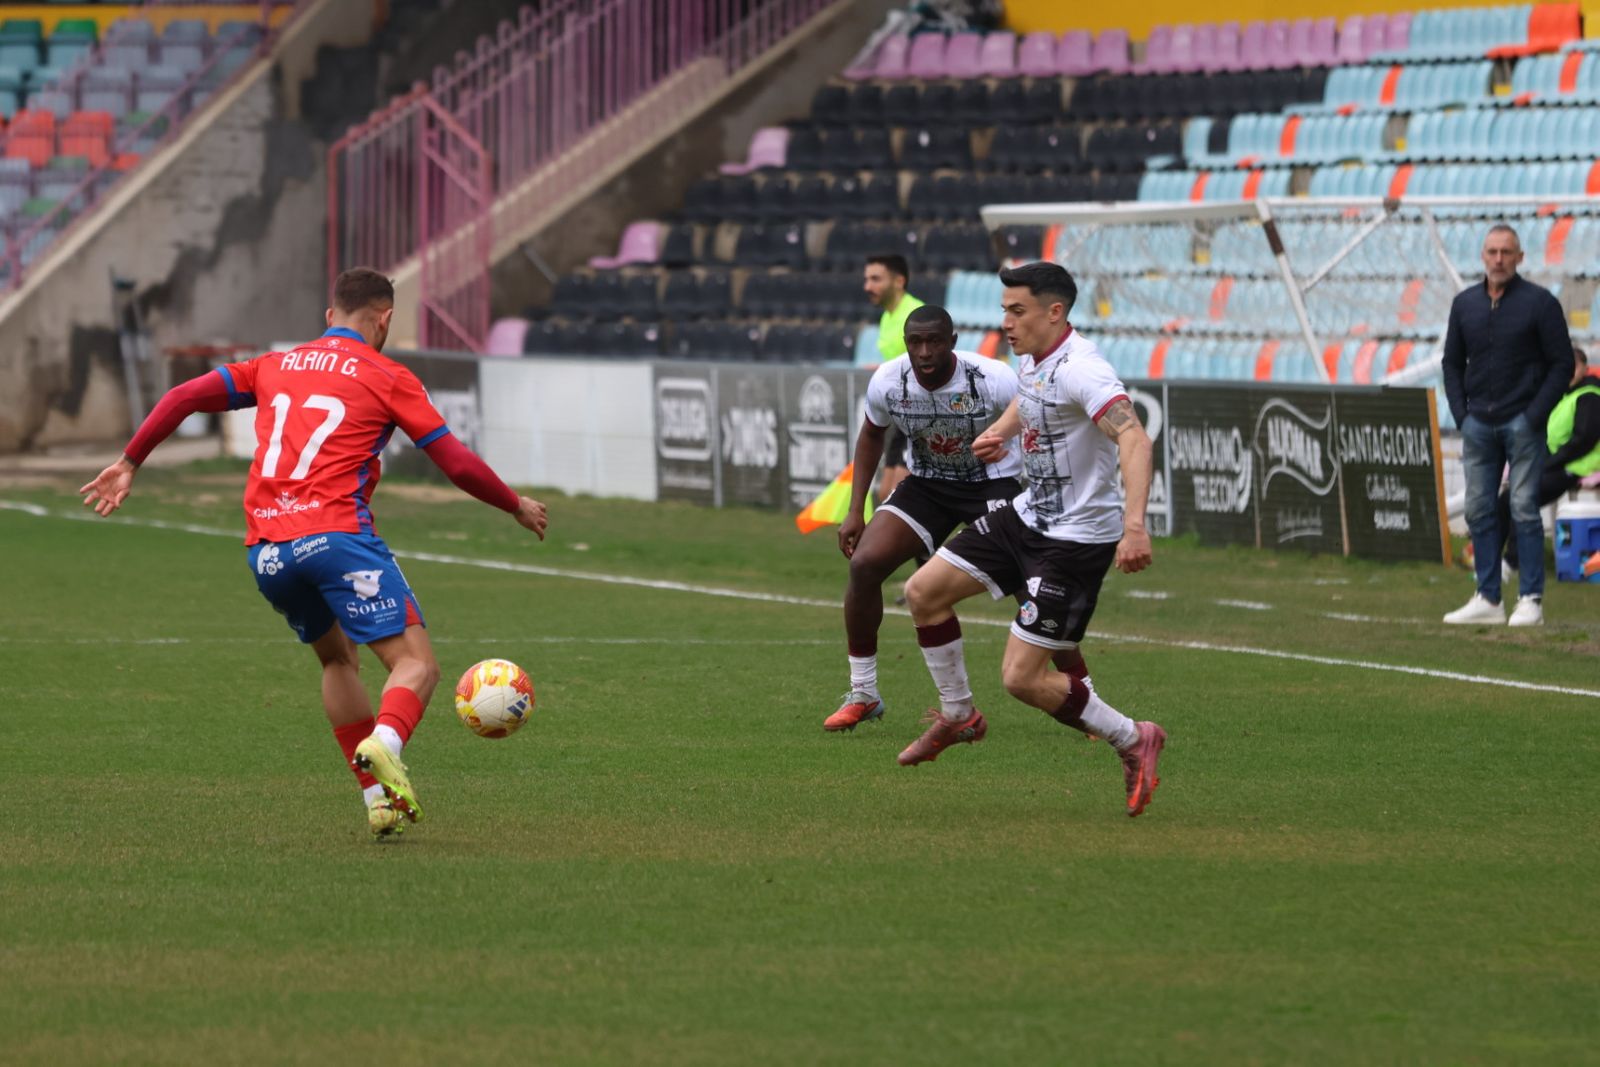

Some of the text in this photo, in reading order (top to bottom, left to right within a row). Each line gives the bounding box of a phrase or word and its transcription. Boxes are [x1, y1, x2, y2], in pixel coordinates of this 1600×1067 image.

[280, 351, 359, 377] ALAIN G.
[261, 393, 346, 480] 17
[1340, 424, 1430, 466] SANTAGLORIA
[1192, 474, 1242, 512] TELECOM
[254, 507, 278, 520] Caja
[292, 500, 320, 513] Soria
[293, 536, 328, 557] Oxígeno
[346, 596, 397, 618] Soria
